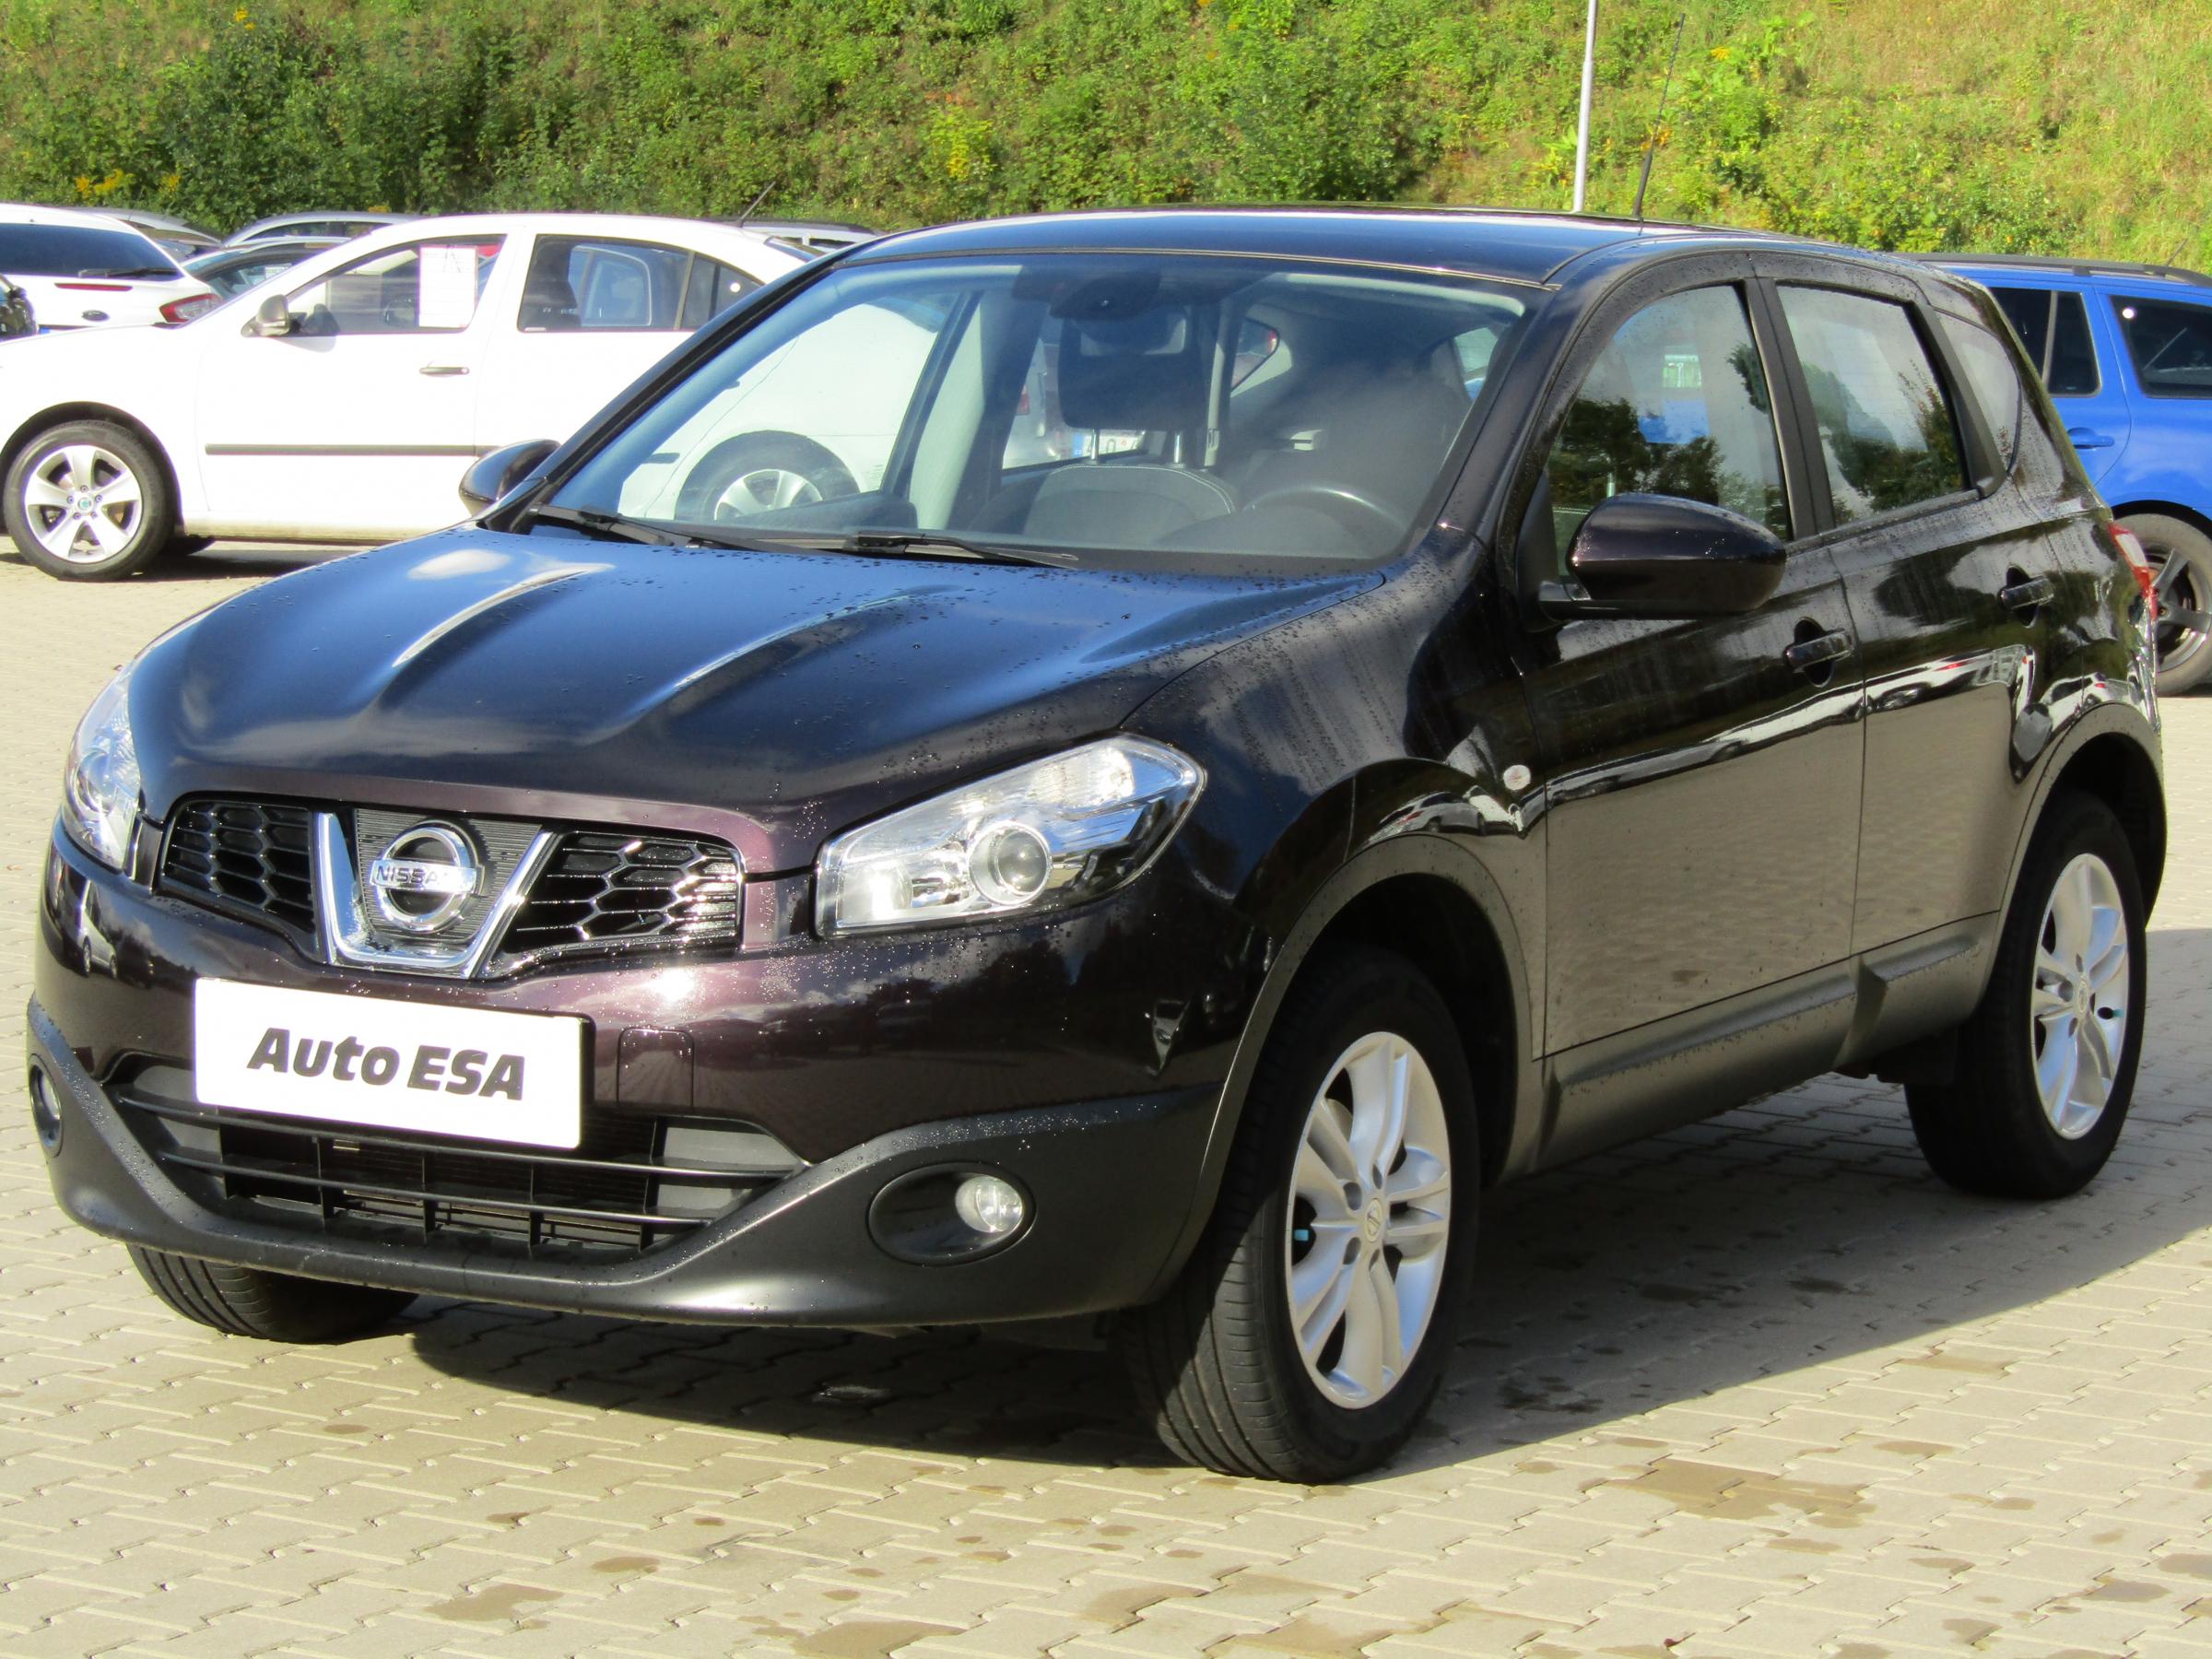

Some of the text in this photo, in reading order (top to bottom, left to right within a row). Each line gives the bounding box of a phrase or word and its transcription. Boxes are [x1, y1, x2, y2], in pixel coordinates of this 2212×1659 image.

[376, 865, 455, 886] NISSA
[246, 1028, 525, 1100] Auto ESA
